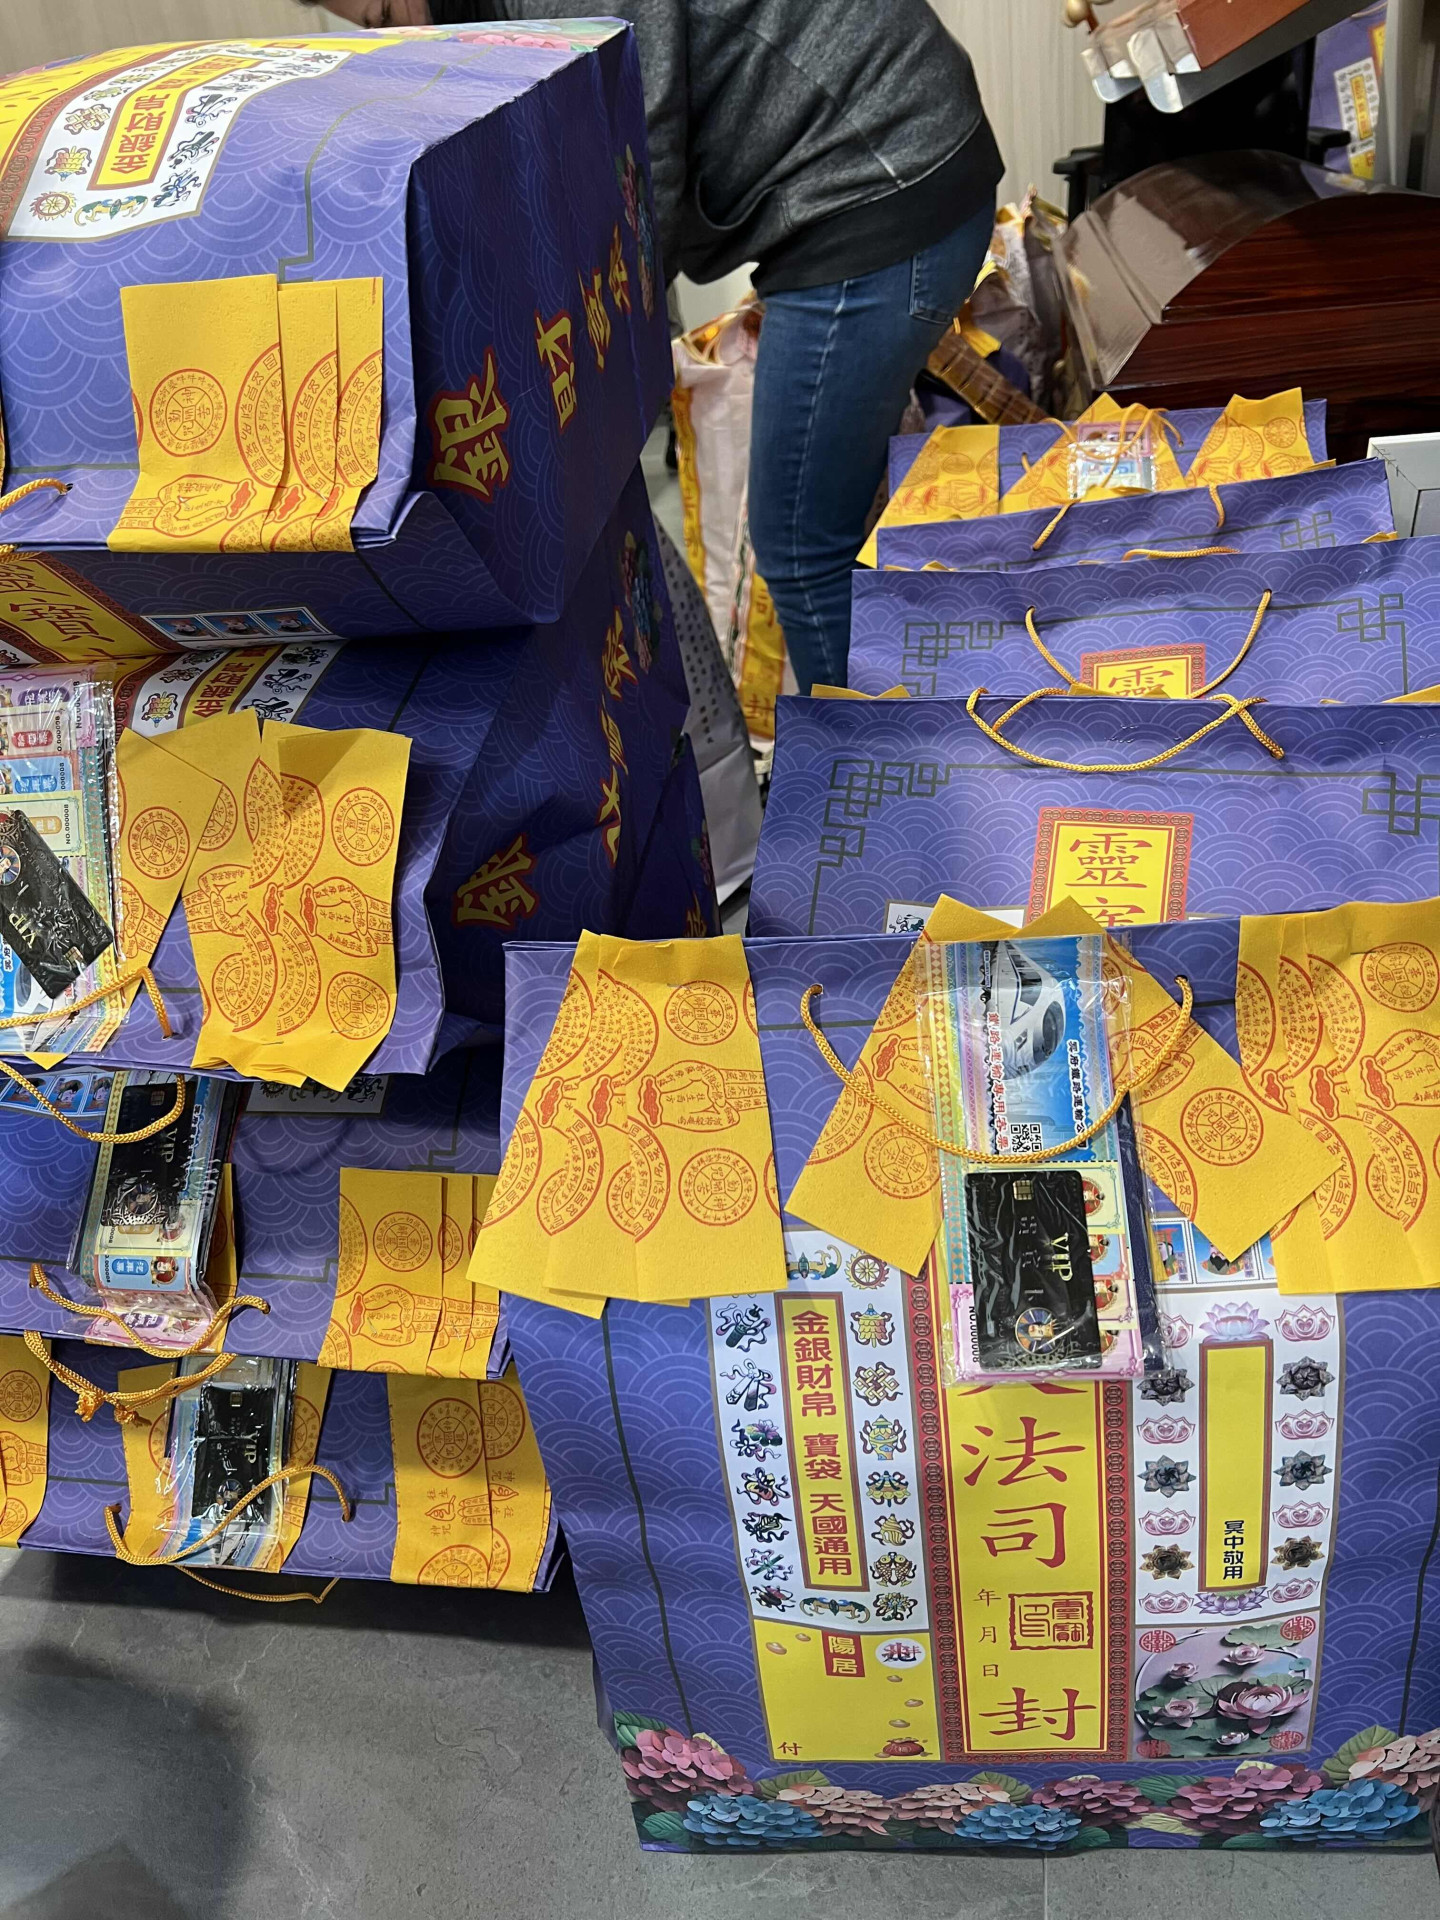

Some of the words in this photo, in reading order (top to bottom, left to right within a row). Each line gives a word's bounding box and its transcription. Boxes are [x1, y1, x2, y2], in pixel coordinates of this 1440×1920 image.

[8, 911, 38, 950] VIP
[161, 1127, 178, 1164] VIP
[1051, 1231, 1074, 1282] VIP
[790, 1309, 837, 1418] 金銀財帛
[802, 1432, 843, 1481] 寶袋
[808, 1492, 854, 1577] 天國通用
[1222, 1519, 1245, 1581] 冥中敬用
[827, 1635, 858, 1676] 陽居
[777, 1740, 803, 1757] 付
